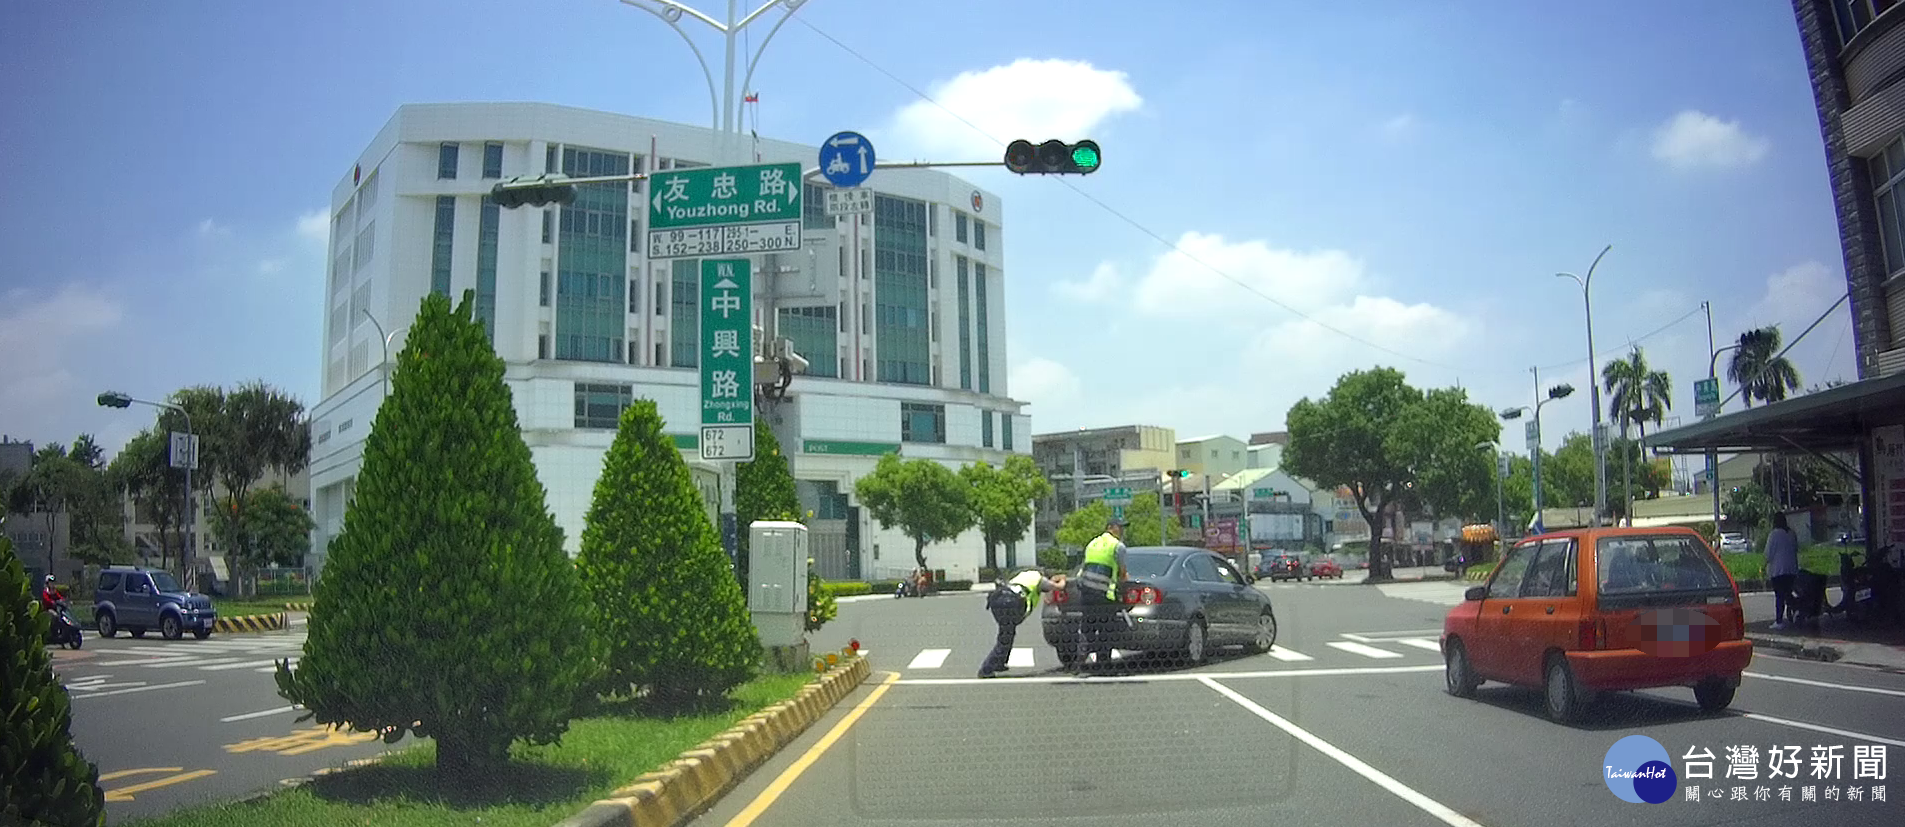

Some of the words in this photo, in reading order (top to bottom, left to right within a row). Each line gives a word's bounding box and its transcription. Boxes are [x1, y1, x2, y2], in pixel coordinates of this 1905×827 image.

[664, 168, 786, 203] 友忠路
[667, 203, 749, 220] Youzhong
[754, 199, 782, 213] Rd.
[666, 241, 720, 255] 152-238
[726, 238, 782, 251] 250-300
[712, 290, 740, 398] 中興路
[703, 400, 750, 411] Zhongxing
[717, 411, 735, 421] Rd.
[705, 430, 724, 440] 672
[705, 446, 724, 456] 672
